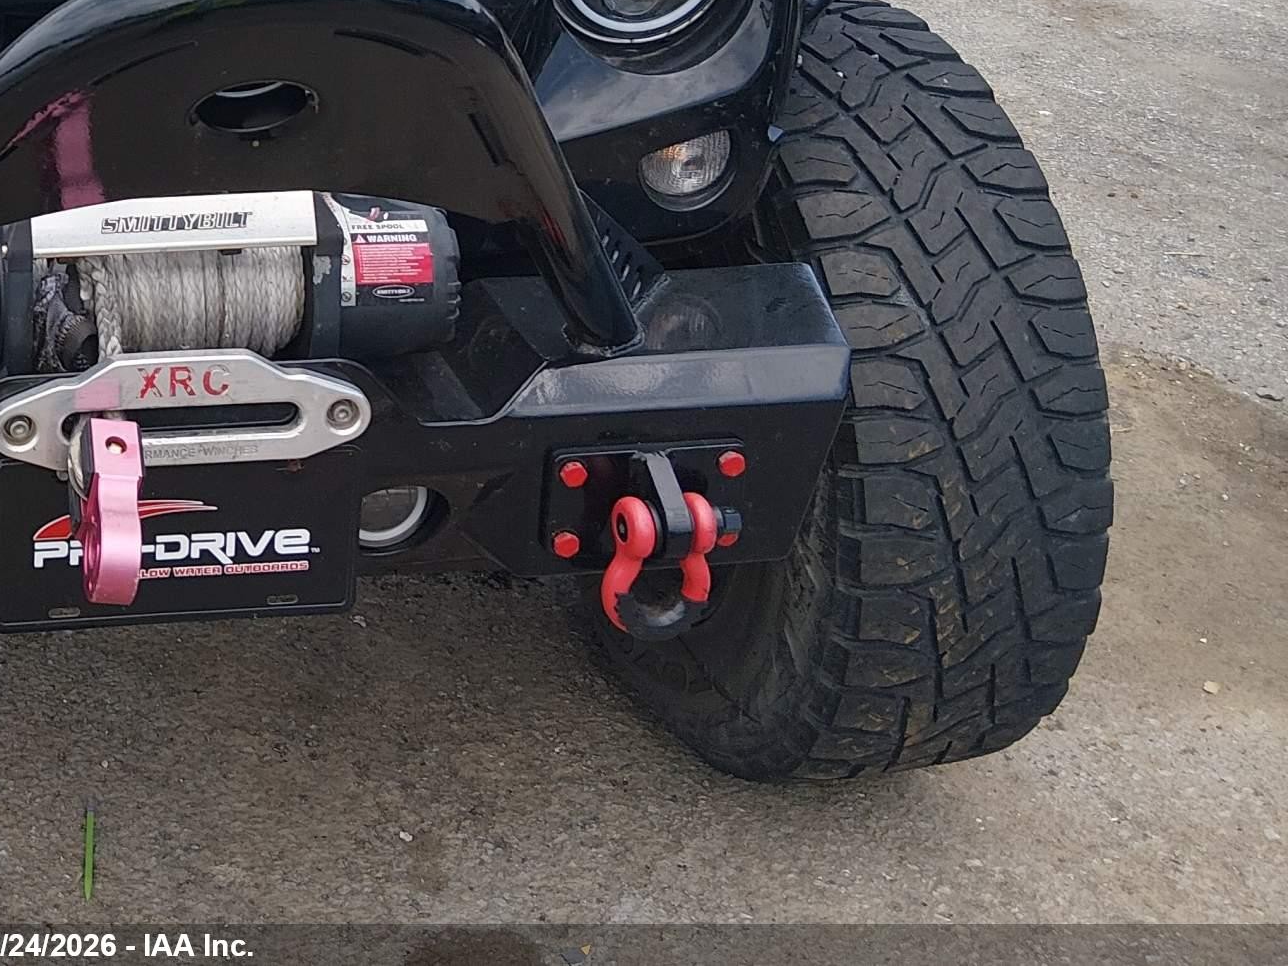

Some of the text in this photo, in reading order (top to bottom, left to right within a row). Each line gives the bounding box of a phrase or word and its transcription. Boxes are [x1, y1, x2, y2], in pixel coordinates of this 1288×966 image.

[101, 212, 253, 234] SMITTYBILT
[367, 234, 417, 242] WARNING
[136, 364, 232, 400] XRC
[173, 564, 222, 577] WATER
[223, 560, 309, 575] OUTBOARDS
